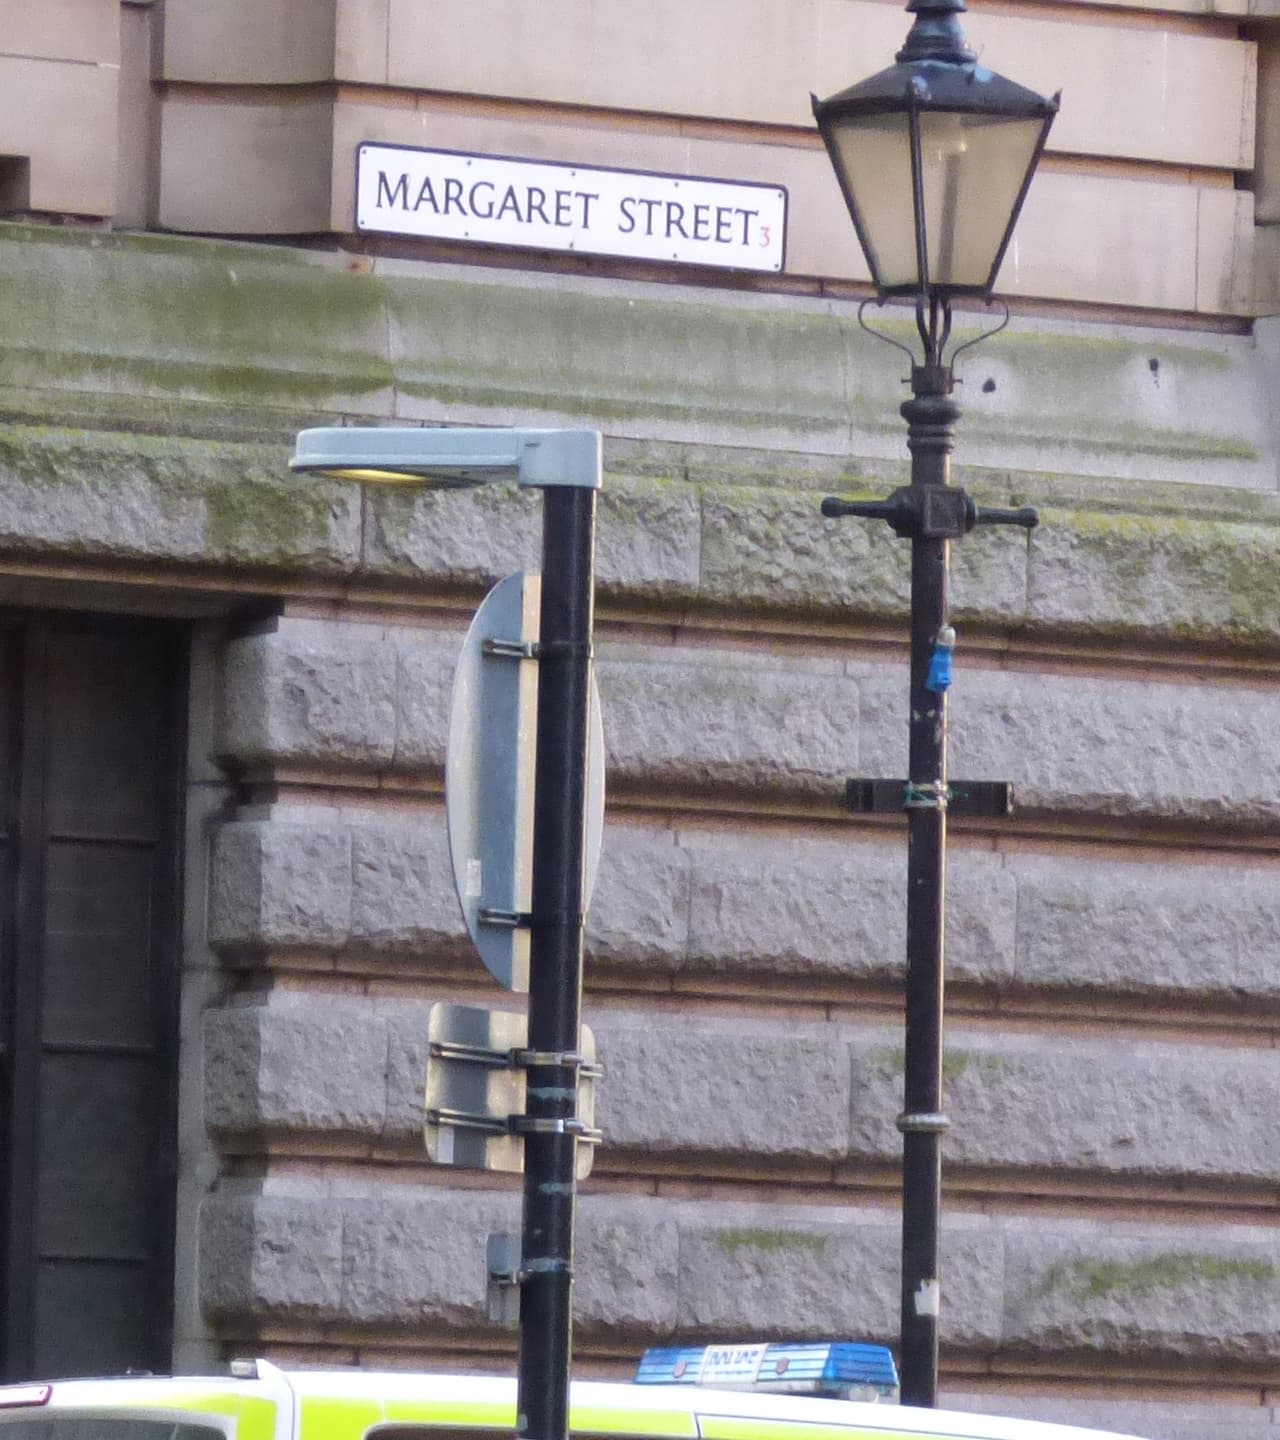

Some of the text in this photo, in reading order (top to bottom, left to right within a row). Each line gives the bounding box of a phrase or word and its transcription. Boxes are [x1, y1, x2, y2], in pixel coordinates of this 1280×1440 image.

[375, 170, 772, 248] MARGARET STREET 3
